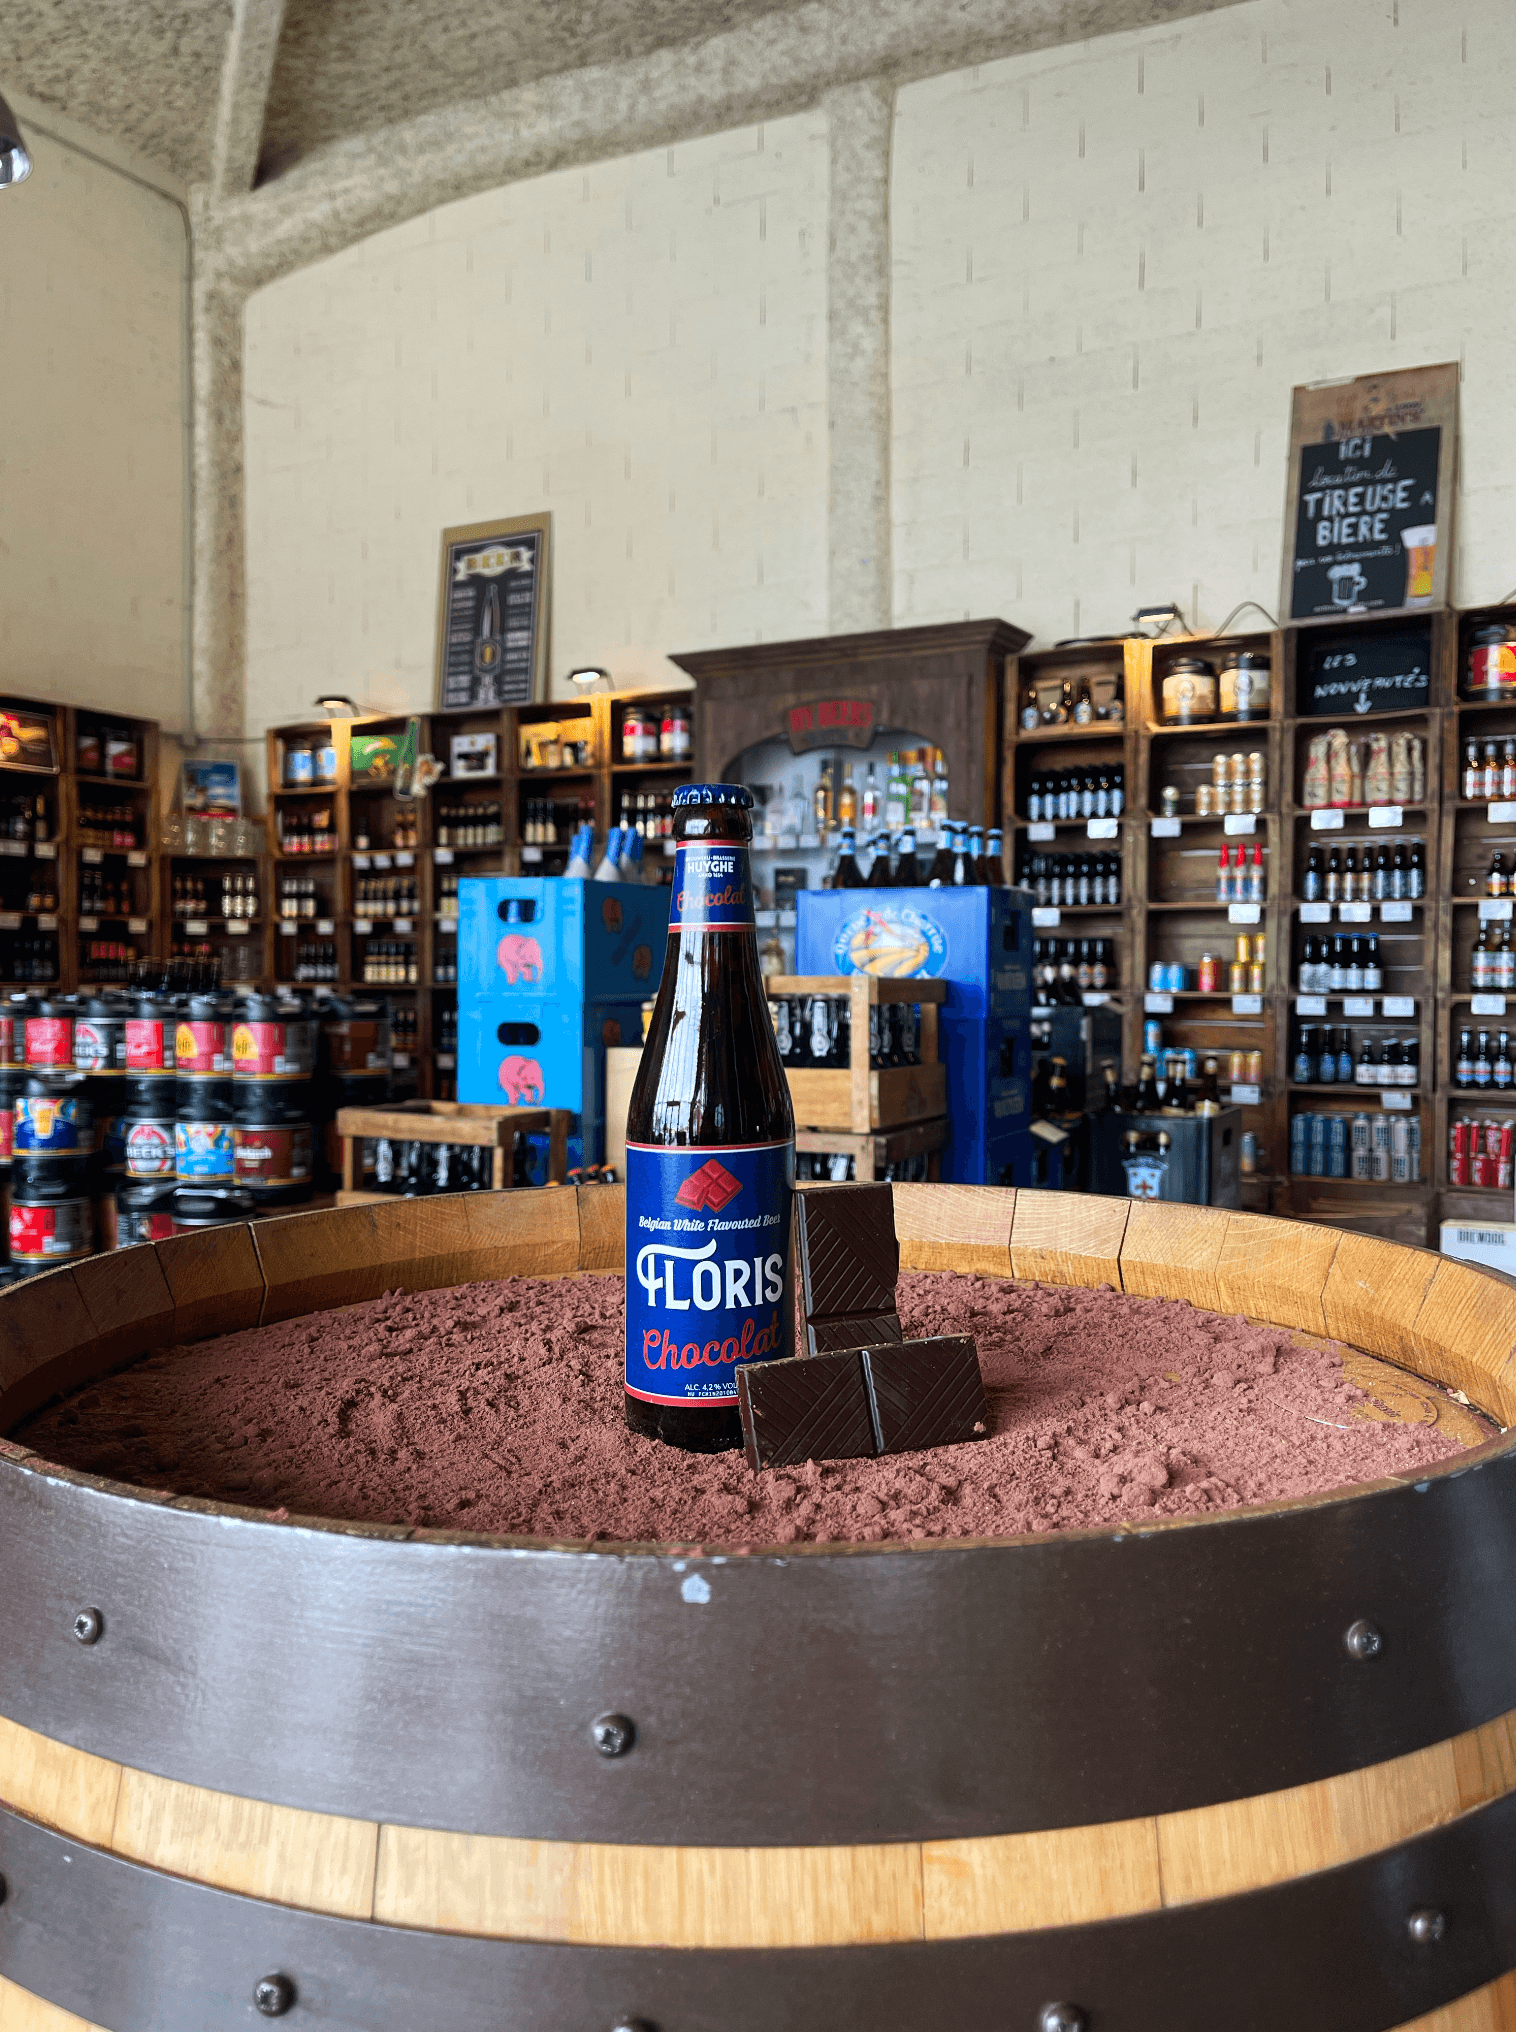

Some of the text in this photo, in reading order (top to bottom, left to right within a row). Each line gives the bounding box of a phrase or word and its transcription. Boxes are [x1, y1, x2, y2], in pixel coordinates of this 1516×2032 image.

[1302, 478, 1417, 520] TIREUSE
[687, 861, 734, 873] HUYGHE
[677, 884, 744, 912] Chocolat
[639, 1213, 781, 1232] Belgian White Flavoured Beer
[636, 1237, 783, 1311] FLORIS
[643, 1309, 783, 1370] Chocolat
[684, 1383, 700, 1391] ALC.
